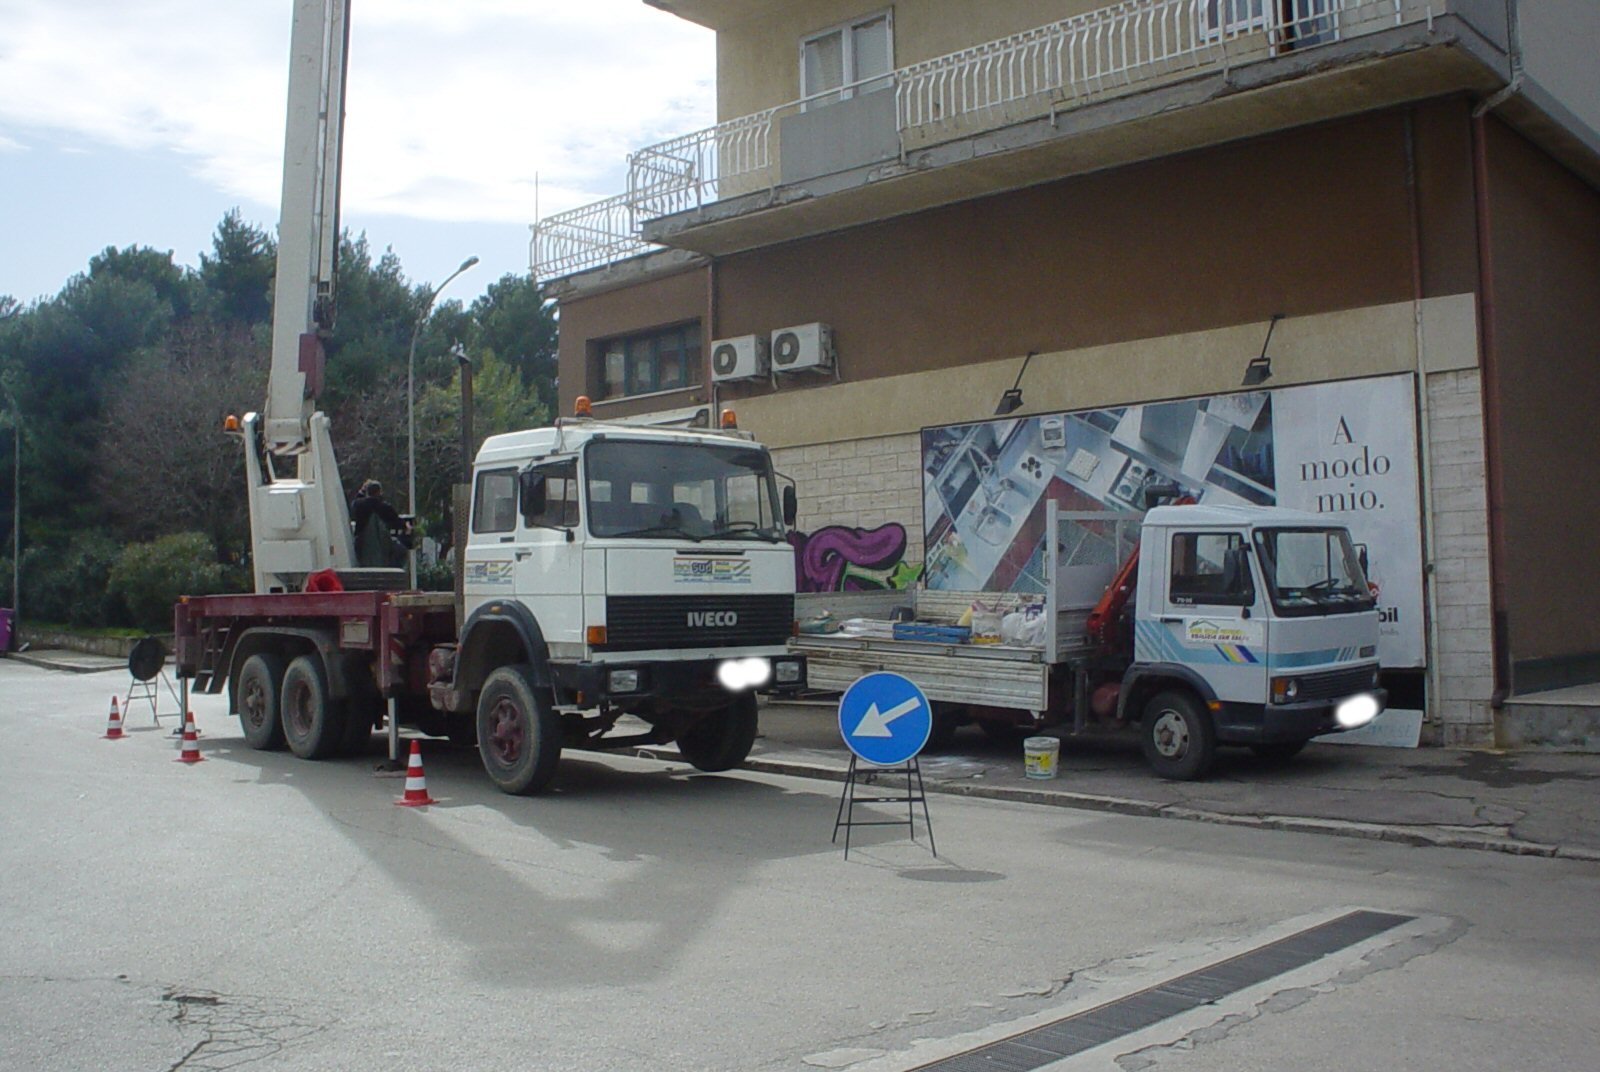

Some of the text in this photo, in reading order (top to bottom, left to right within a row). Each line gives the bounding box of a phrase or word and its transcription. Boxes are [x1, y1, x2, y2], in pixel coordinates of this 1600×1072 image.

[1332, 415, 1356, 445] A
[1300, 445, 1390, 481] modo
[1315, 482, 1384, 513] mio.
[687, 611, 738, 627] IVECO
